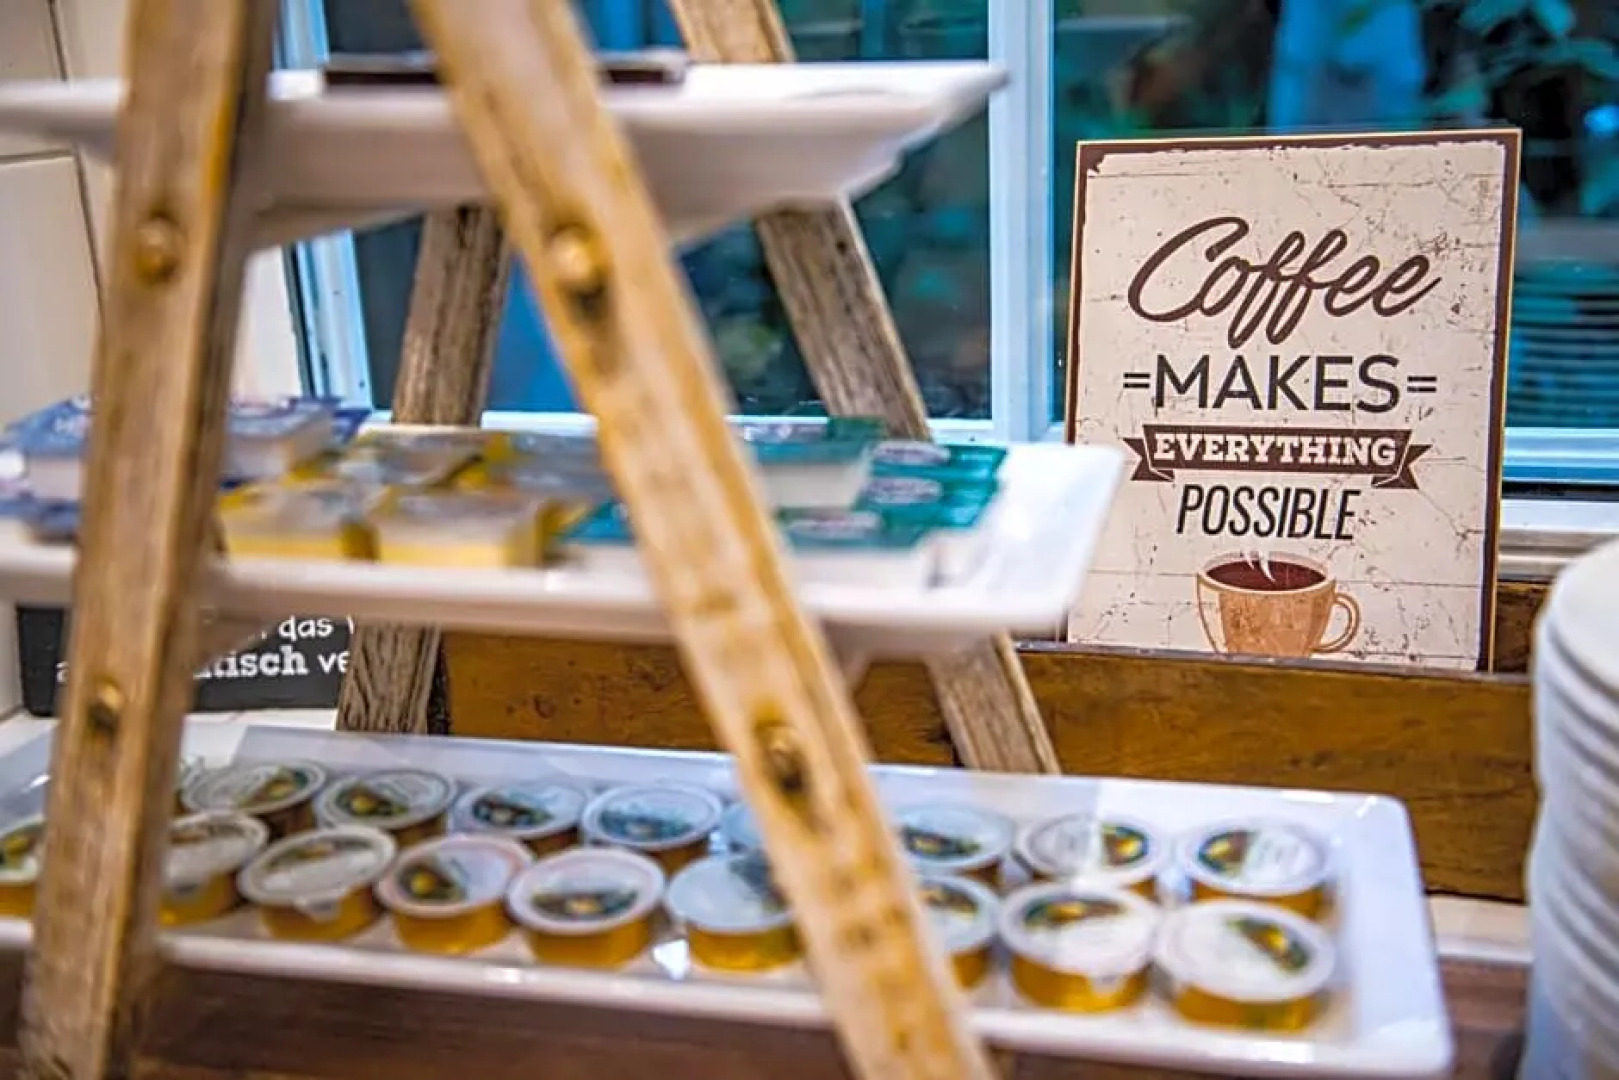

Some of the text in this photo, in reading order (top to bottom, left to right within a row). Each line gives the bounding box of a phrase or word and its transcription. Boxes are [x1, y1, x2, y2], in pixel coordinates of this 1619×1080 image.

[1128, 217, 1442, 348] Coffee
[1152, 432, 1398, 467] EVERYTHING
[1176, 485, 1361, 540] POSSIBLE
